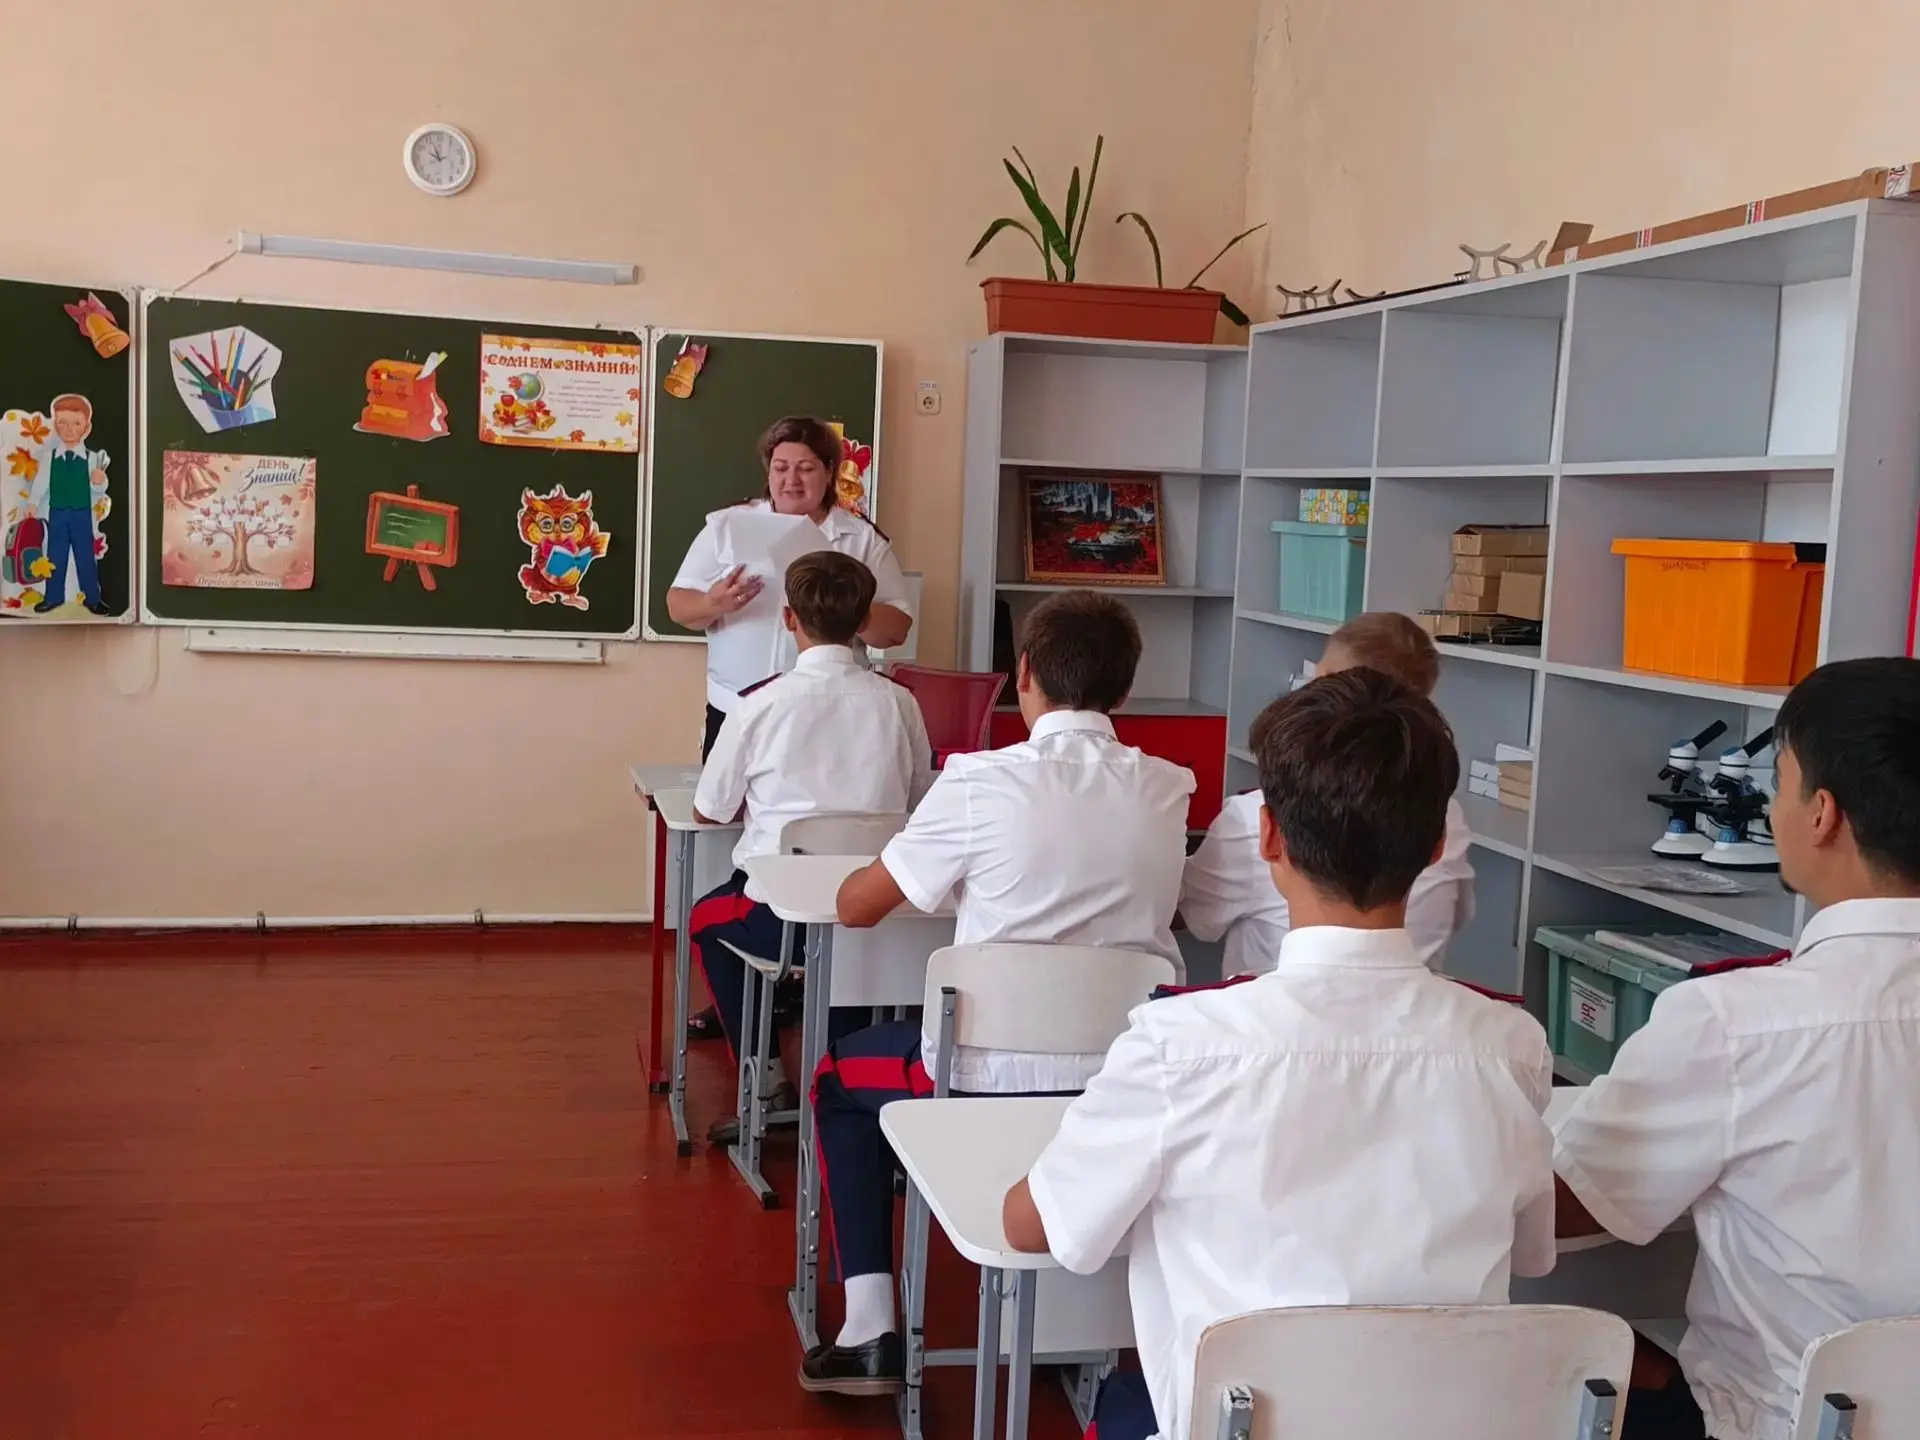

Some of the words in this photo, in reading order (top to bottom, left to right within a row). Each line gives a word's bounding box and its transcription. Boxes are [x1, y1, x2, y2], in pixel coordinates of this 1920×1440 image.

[487, 354, 498, 366] С
[505, 355, 553, 369] ДНЕМ
[564, 359, 636, 375] ЗНАНИЙ!
[257, 459, 289, 470] ДЕНЬ
[238, 463, 306, 493] Знаний!
